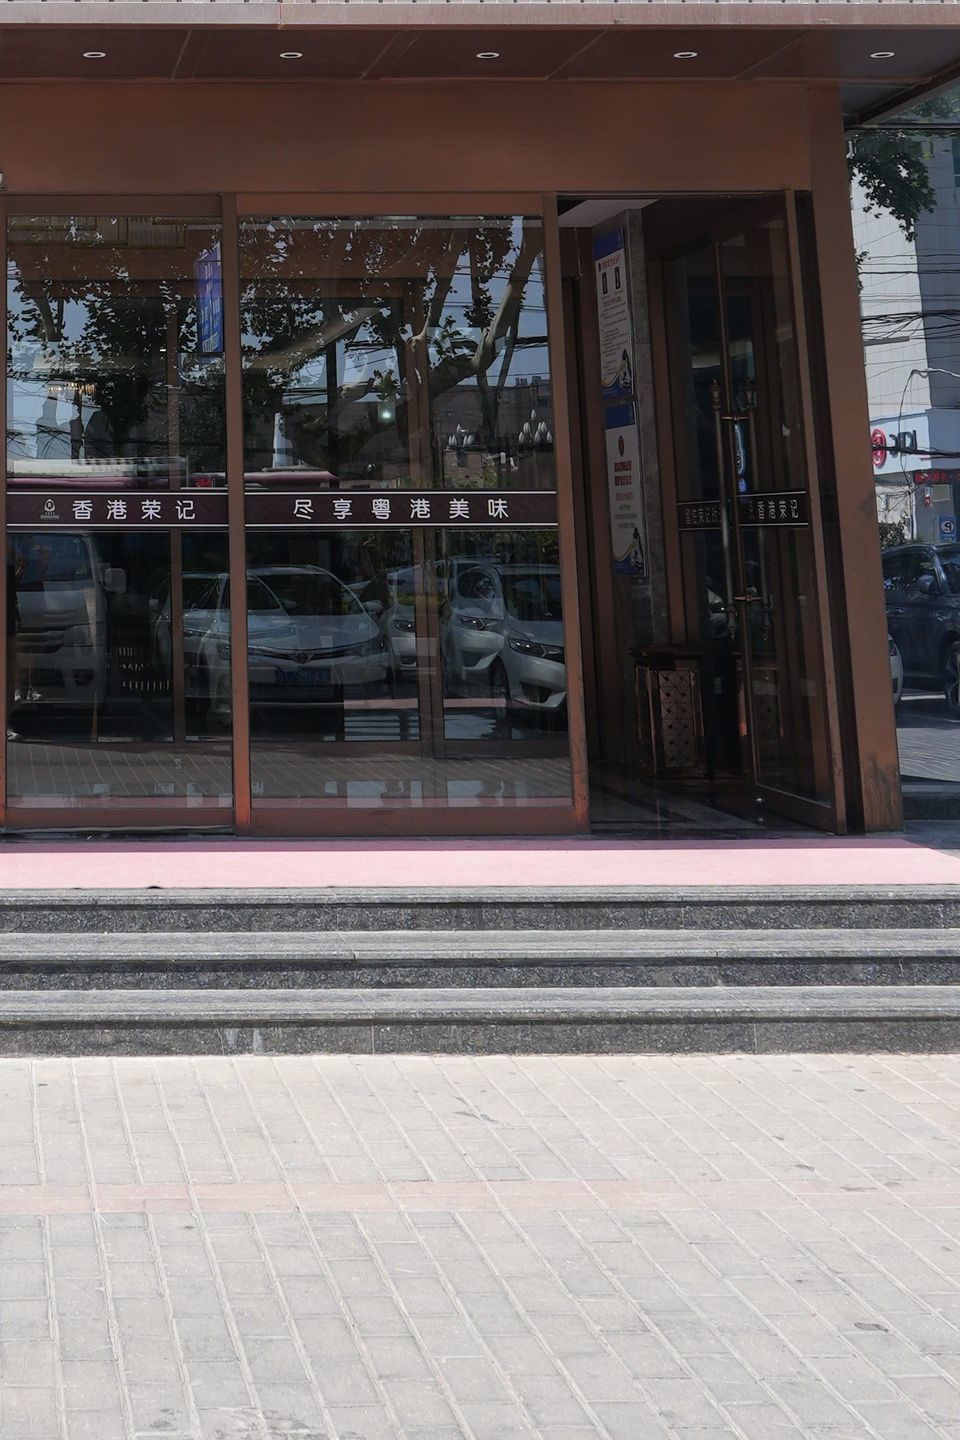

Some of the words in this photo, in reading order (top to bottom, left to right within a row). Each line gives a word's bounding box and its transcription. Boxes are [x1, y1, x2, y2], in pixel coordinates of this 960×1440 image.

[72, 499, 196, 520] 香港荣记
[293, 498, 510, 520] 尽享粤港美味
